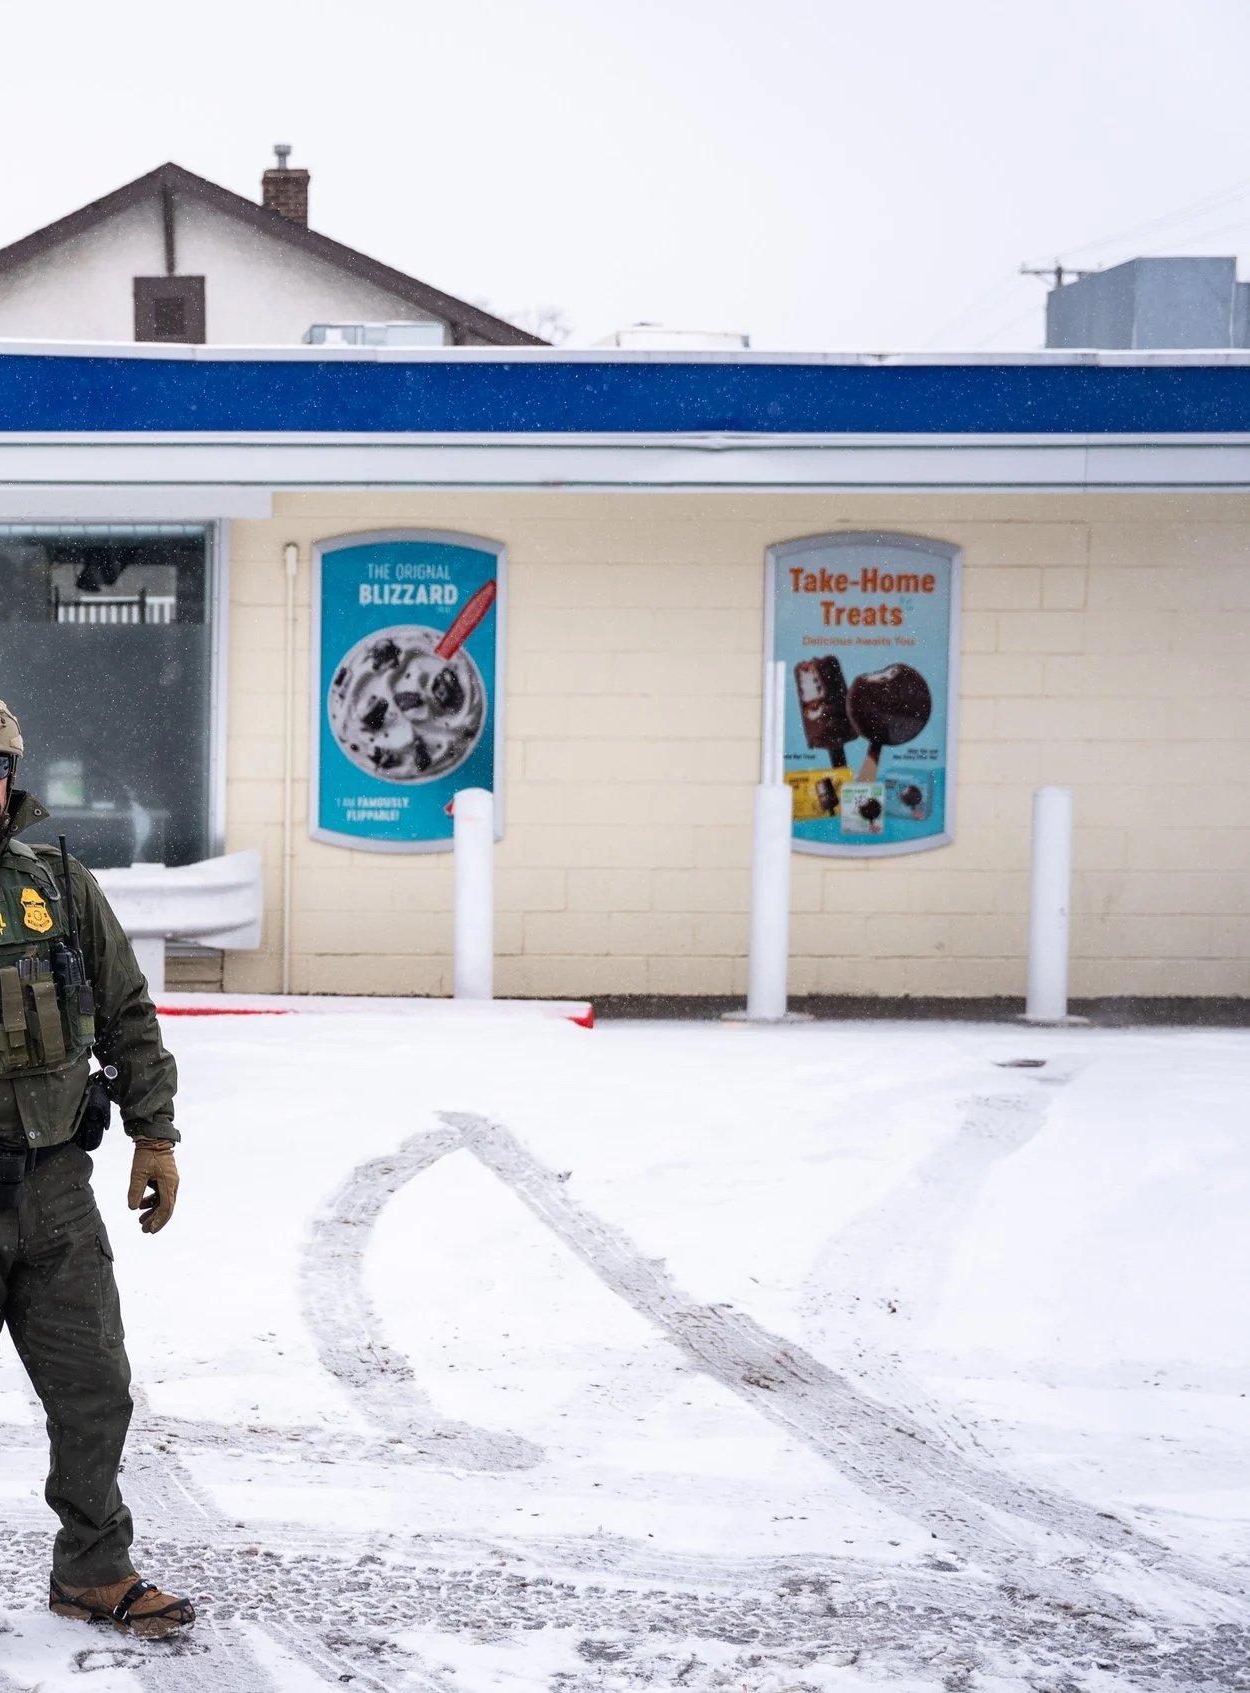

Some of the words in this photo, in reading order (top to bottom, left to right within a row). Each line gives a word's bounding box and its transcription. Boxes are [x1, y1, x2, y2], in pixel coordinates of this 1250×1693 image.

[368, 563, 390, 580] THE
[789, 566, 936, 593] Take-Home
[358, 584, 459, 605] BLIZZARD
[820, 600, 903, 627] Treats
[802, 635, 852, 646] Delicious
[855, 635, 891, 647] Awaits
[894, 635, 916, 646] You
